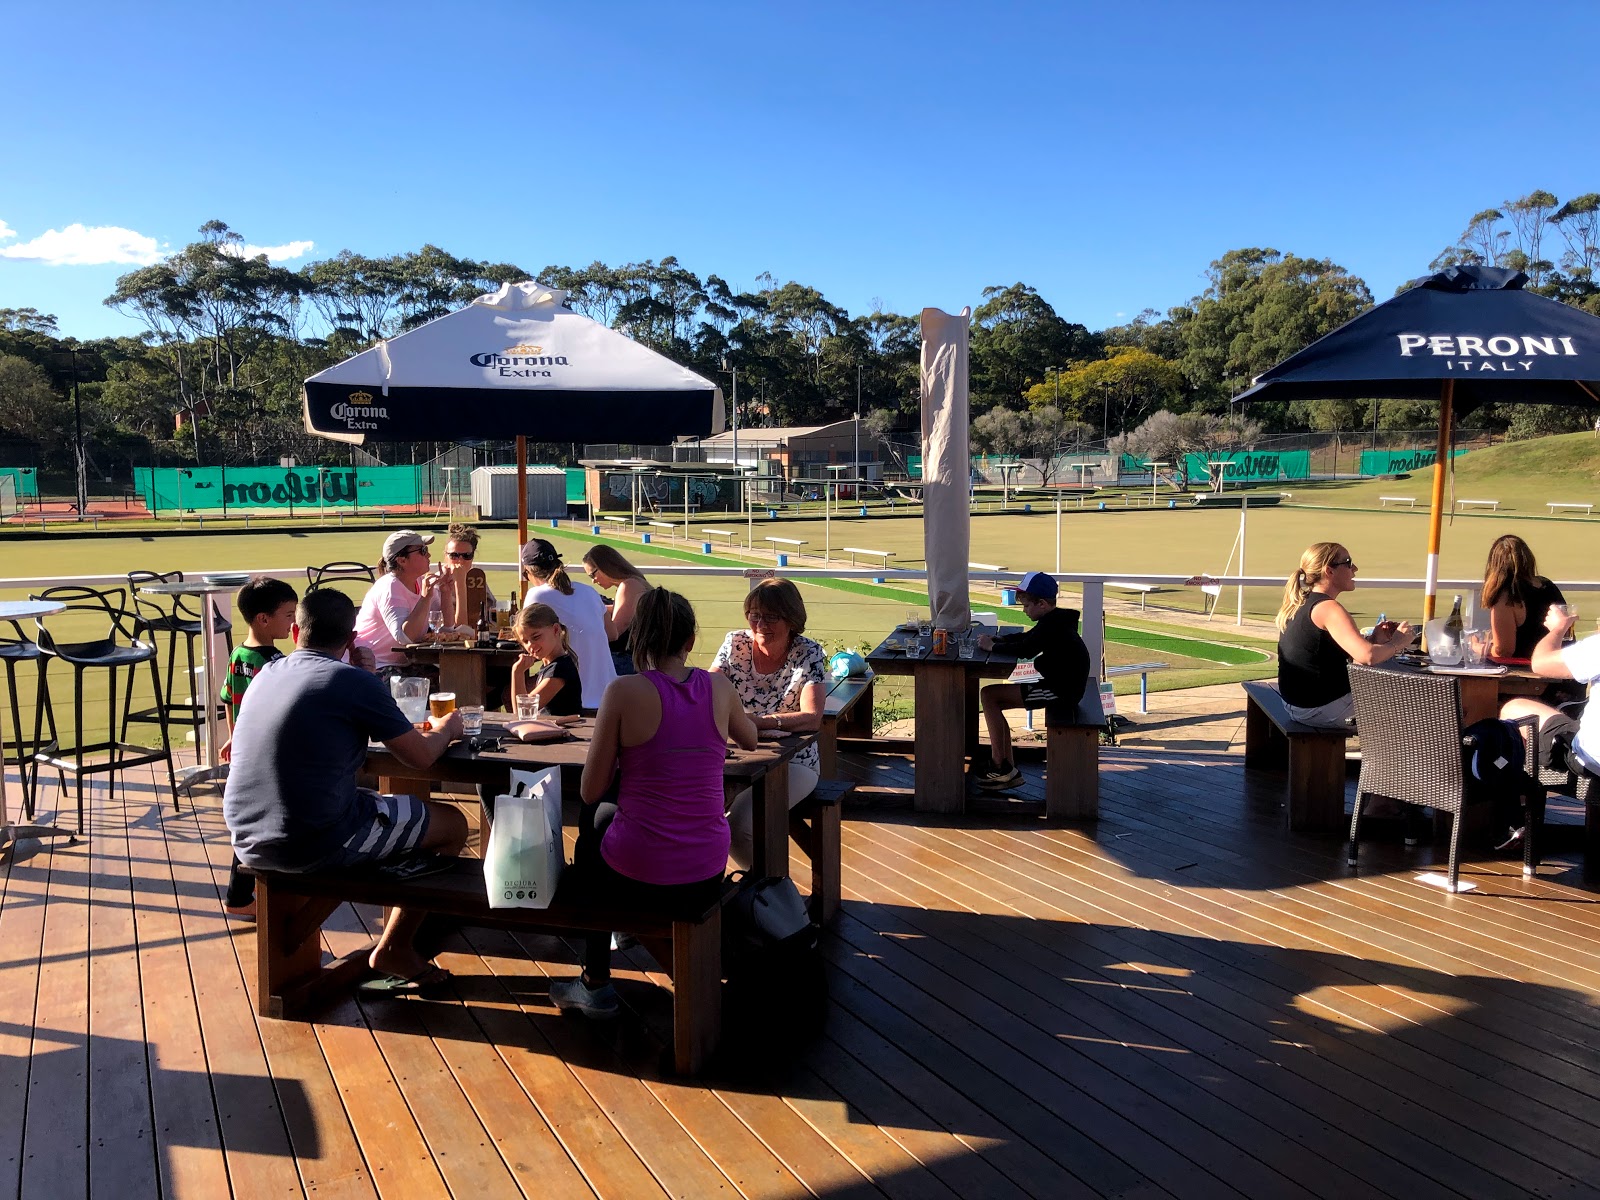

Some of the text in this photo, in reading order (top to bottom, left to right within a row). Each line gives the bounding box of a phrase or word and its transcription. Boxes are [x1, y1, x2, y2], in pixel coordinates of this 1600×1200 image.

[1397, 334, 1578, 357] PERONI
[469, 352, 569, 369] Corona
[1446, 360, 1534, 371] ITALY
[499, 366, 552, 377] Extra
[330, 402, 388, 421] Corona
[347, 417, 378, 429] Extra
[467, 576, 485, 589] 32
